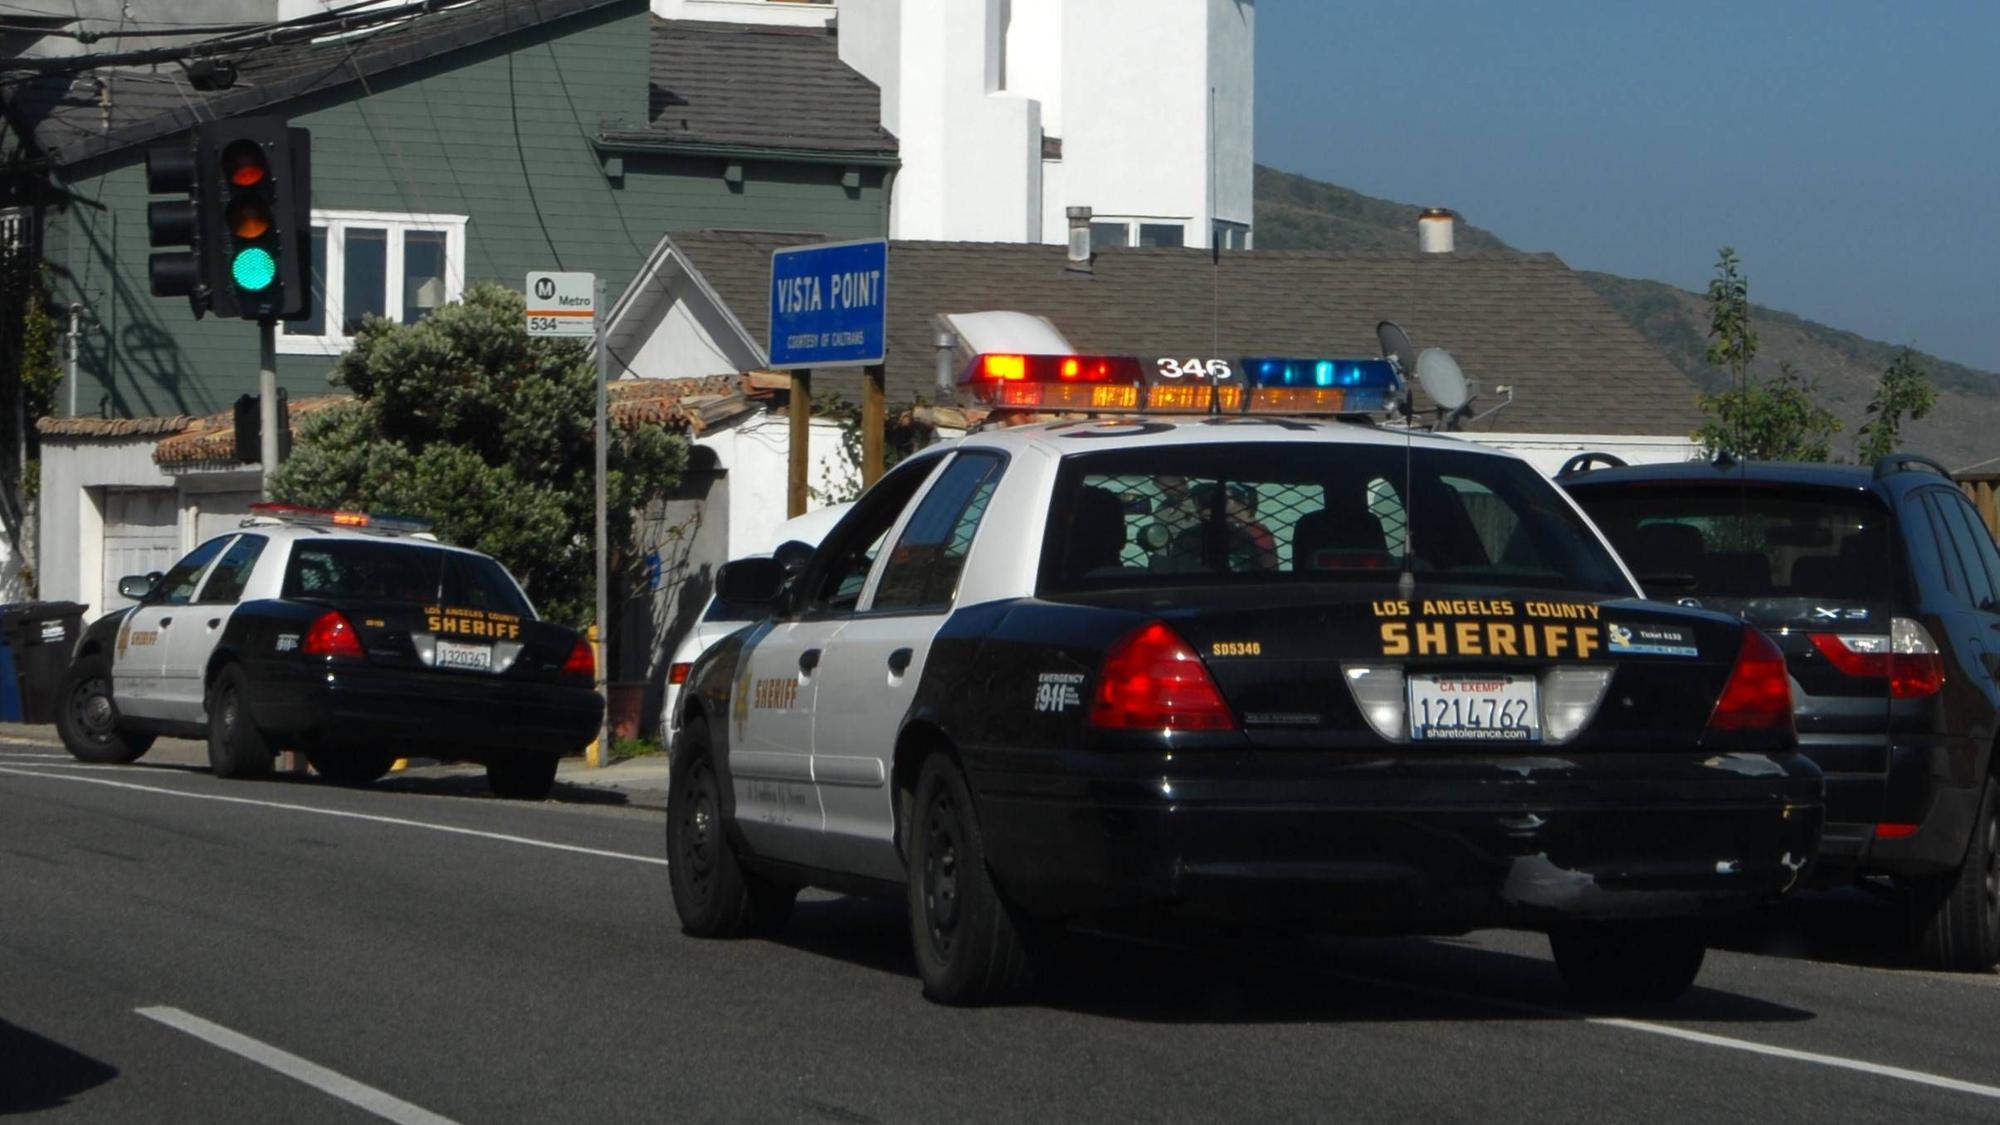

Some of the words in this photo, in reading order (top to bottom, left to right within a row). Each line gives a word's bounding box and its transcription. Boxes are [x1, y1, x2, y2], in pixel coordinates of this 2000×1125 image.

[778, 275, 822, 313] VISTA
[830, 270, 880, 310] POINT
[559, 296, 591, 306] Metro
[530, 317, 557, 331] 534
[821, 333, 830, 347] OF
[1157, 358, 1232, 379] 346
[424, 606, 441, 615] LOS
[445, 607, 484, 618] ANGELES
[488, 611, 519, 622] COUNTY
[1373, 601, 1410, 616] LOS
[1423, 600, 1514, 616] ANGELES
[1525, 602, 1599, 620] COUNTY
[1814, 606, 1869, 620] X3
[428, 616, 520, 639] SHERIFF
[1380, 622, 1599, 659] SHERIFF
[755, 678, 799, 709] SHERIFF
[1440, 682, 1455, 692] CA
[1462, 682, 1505, 692] EXEMPT
[1421, 698, 1528, 728] 1214762
[1427, 728, 1527, 738] sharetolerance.com
